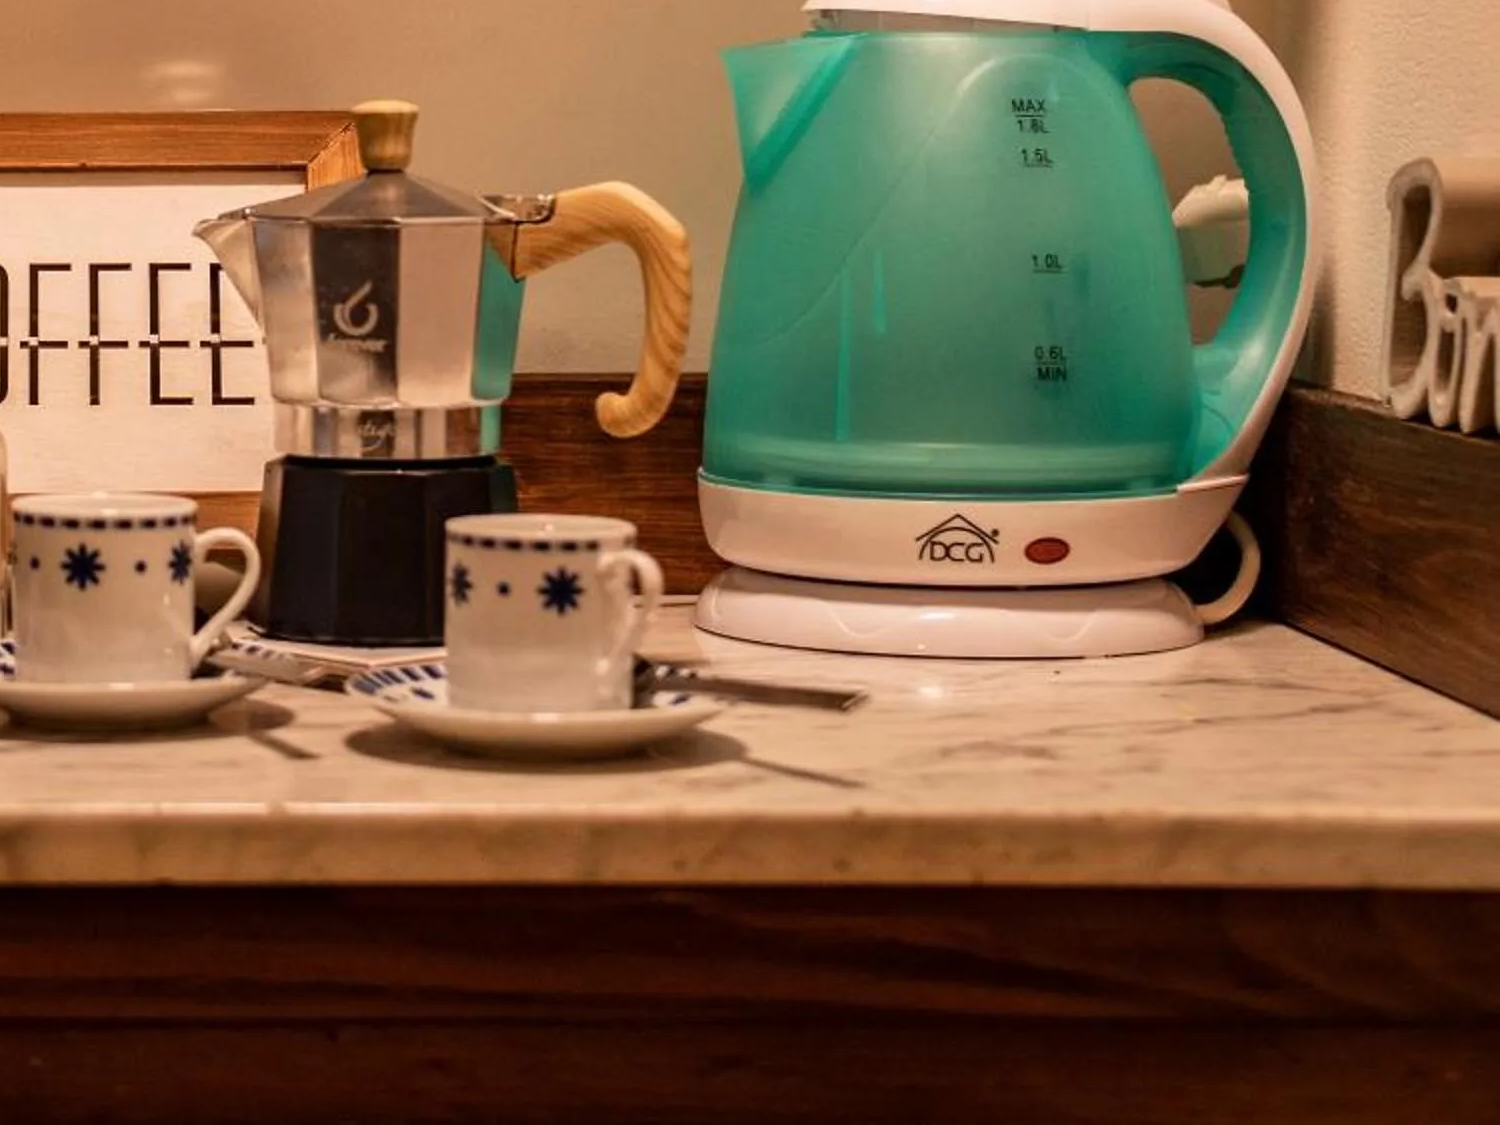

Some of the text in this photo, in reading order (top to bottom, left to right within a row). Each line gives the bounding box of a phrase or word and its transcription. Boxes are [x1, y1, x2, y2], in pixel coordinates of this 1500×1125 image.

[1010, 98, 1046, 113] MAX
[1036, 366, 1068, 381] MIN
[929, 540, 985, 564] DCG
